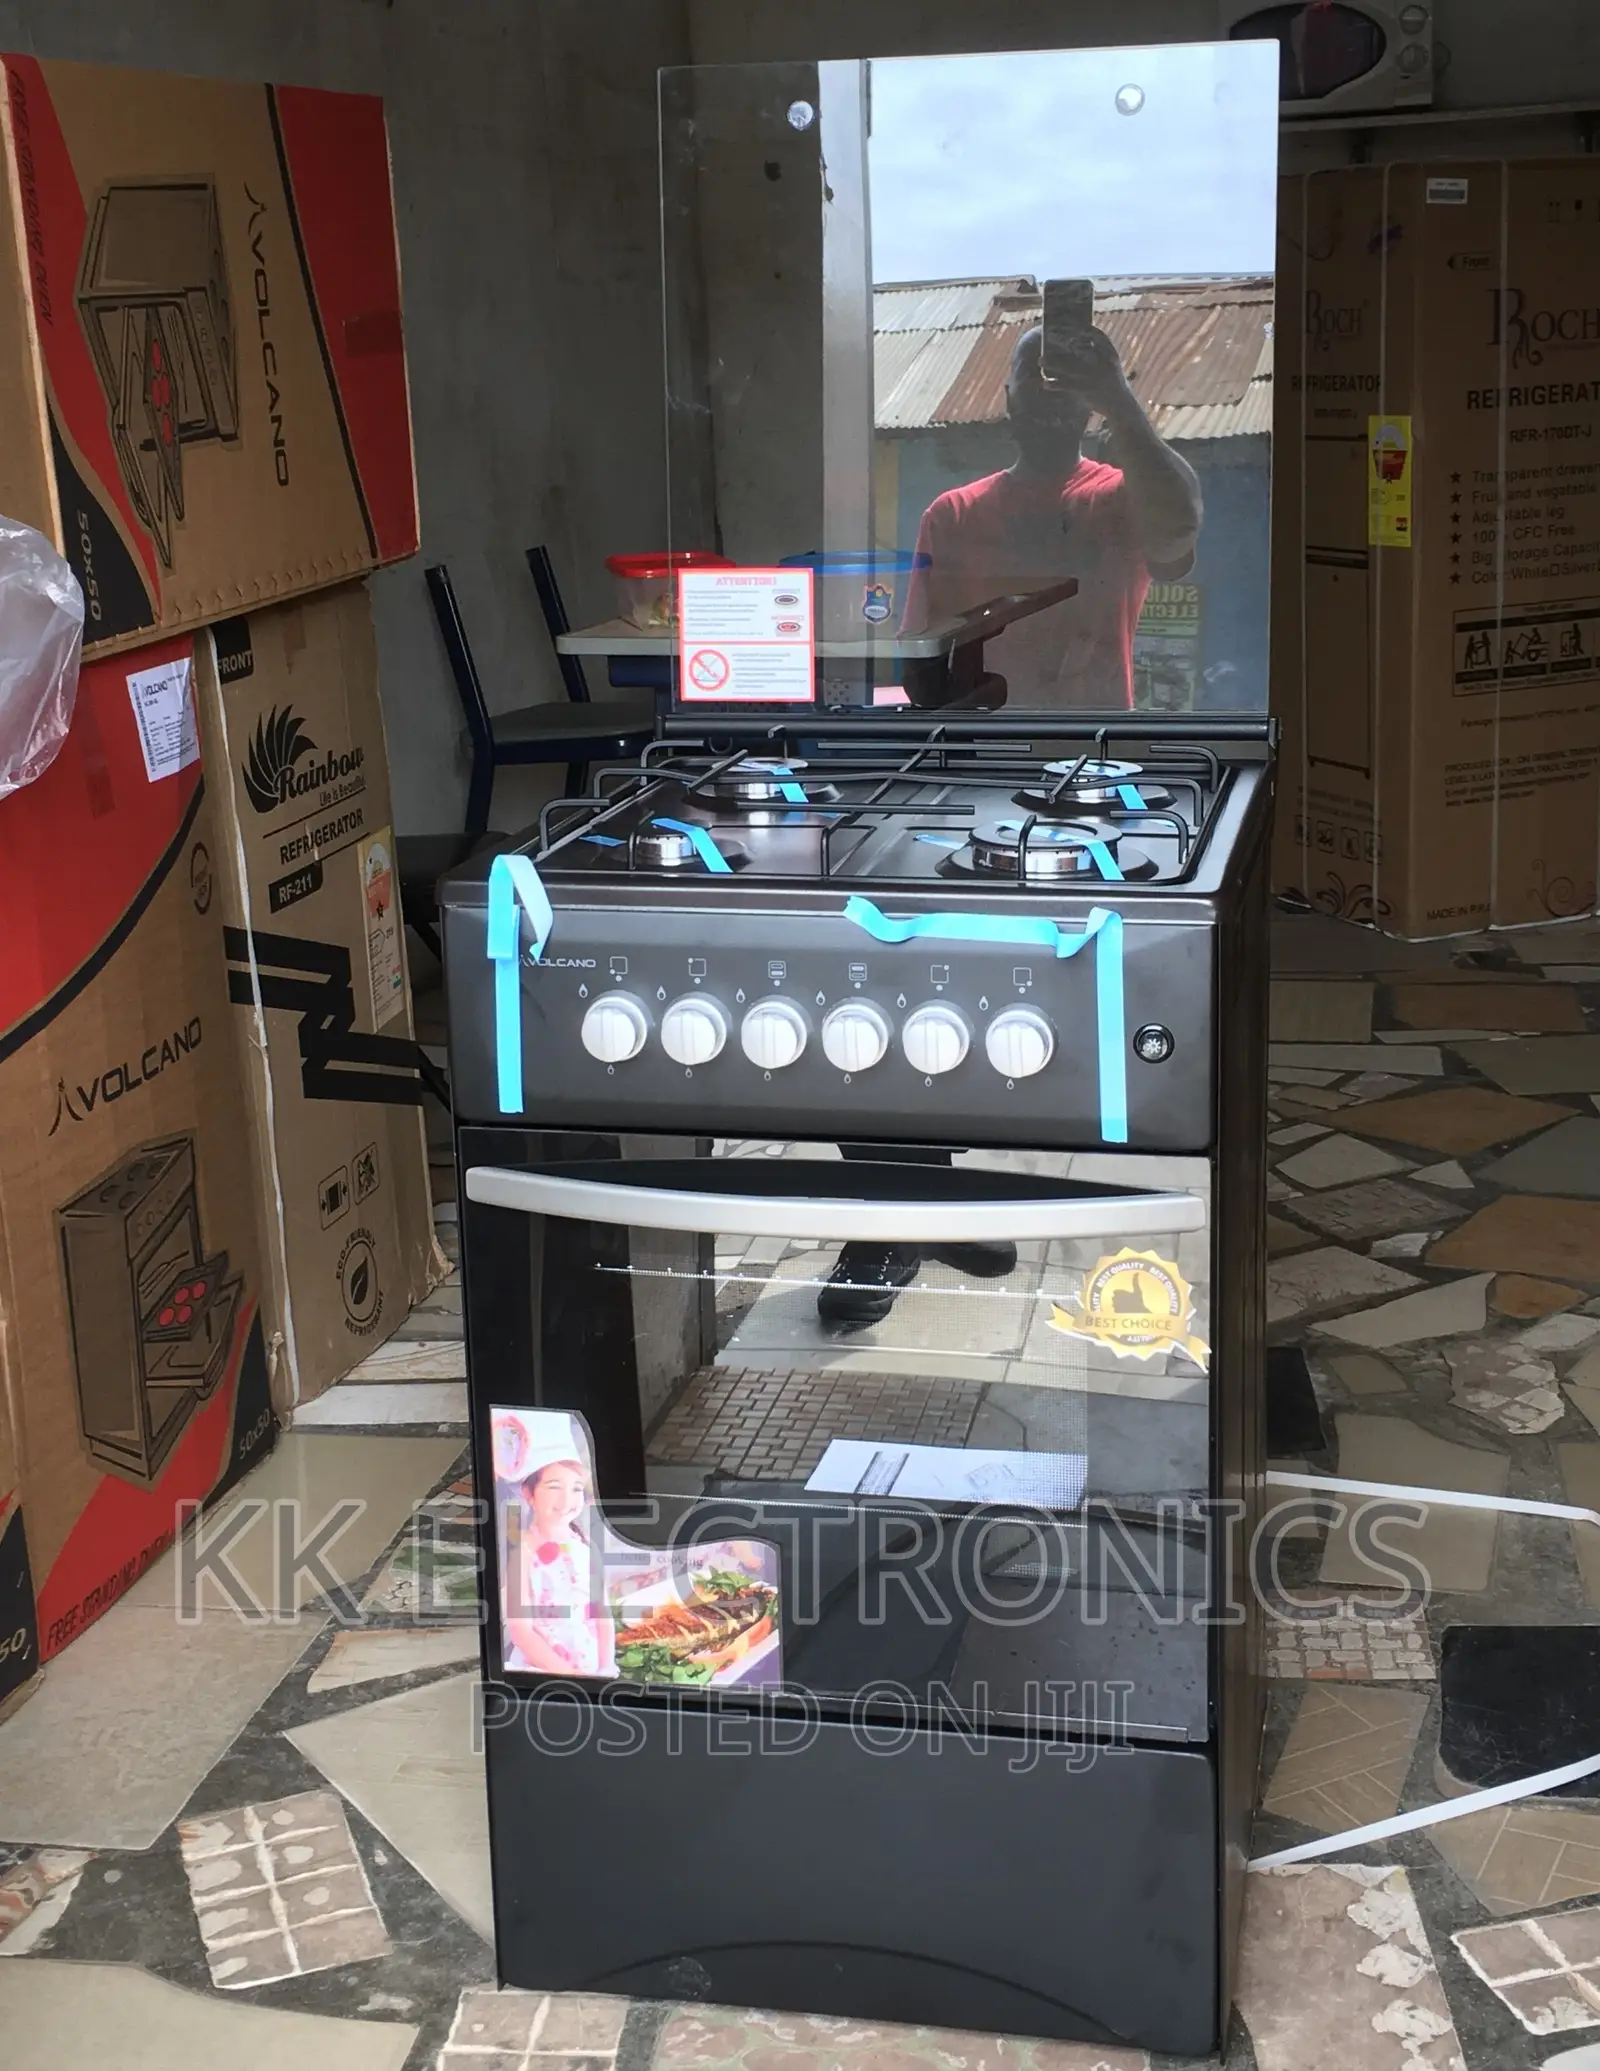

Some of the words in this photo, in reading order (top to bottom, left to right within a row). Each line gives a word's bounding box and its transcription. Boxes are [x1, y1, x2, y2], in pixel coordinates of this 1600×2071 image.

[1485, 287, 1600, 369] ROCH
[248, 226, 289, 488] VOLCANO
[1471, 490, 1502, 504] Frui
[1471, 506, 1542, 525] Adjutable
[1471, 550, 1493, 566] Big
[1500, 547, 1549, 562] torage
[1512, 525, 1544, 541] CFC
[76, 507, 102, 621] 50x50
[217, 651, 253, 675] FRONT
[273, 746, 364, 805] Rainbow
[279, 807, 365, 865] REFRIGERATOR
[278, 872, 313, 904] RF-211
[76, 1016, 202, 1113] VOLCANO
[1085, 1315, 1117, 1329] BEST
[1120, 1317, 1173, 1331] CHOICE
[238, 1408, 271, 1461] 50x50
[46, 1603, 80, 1653] FREE
